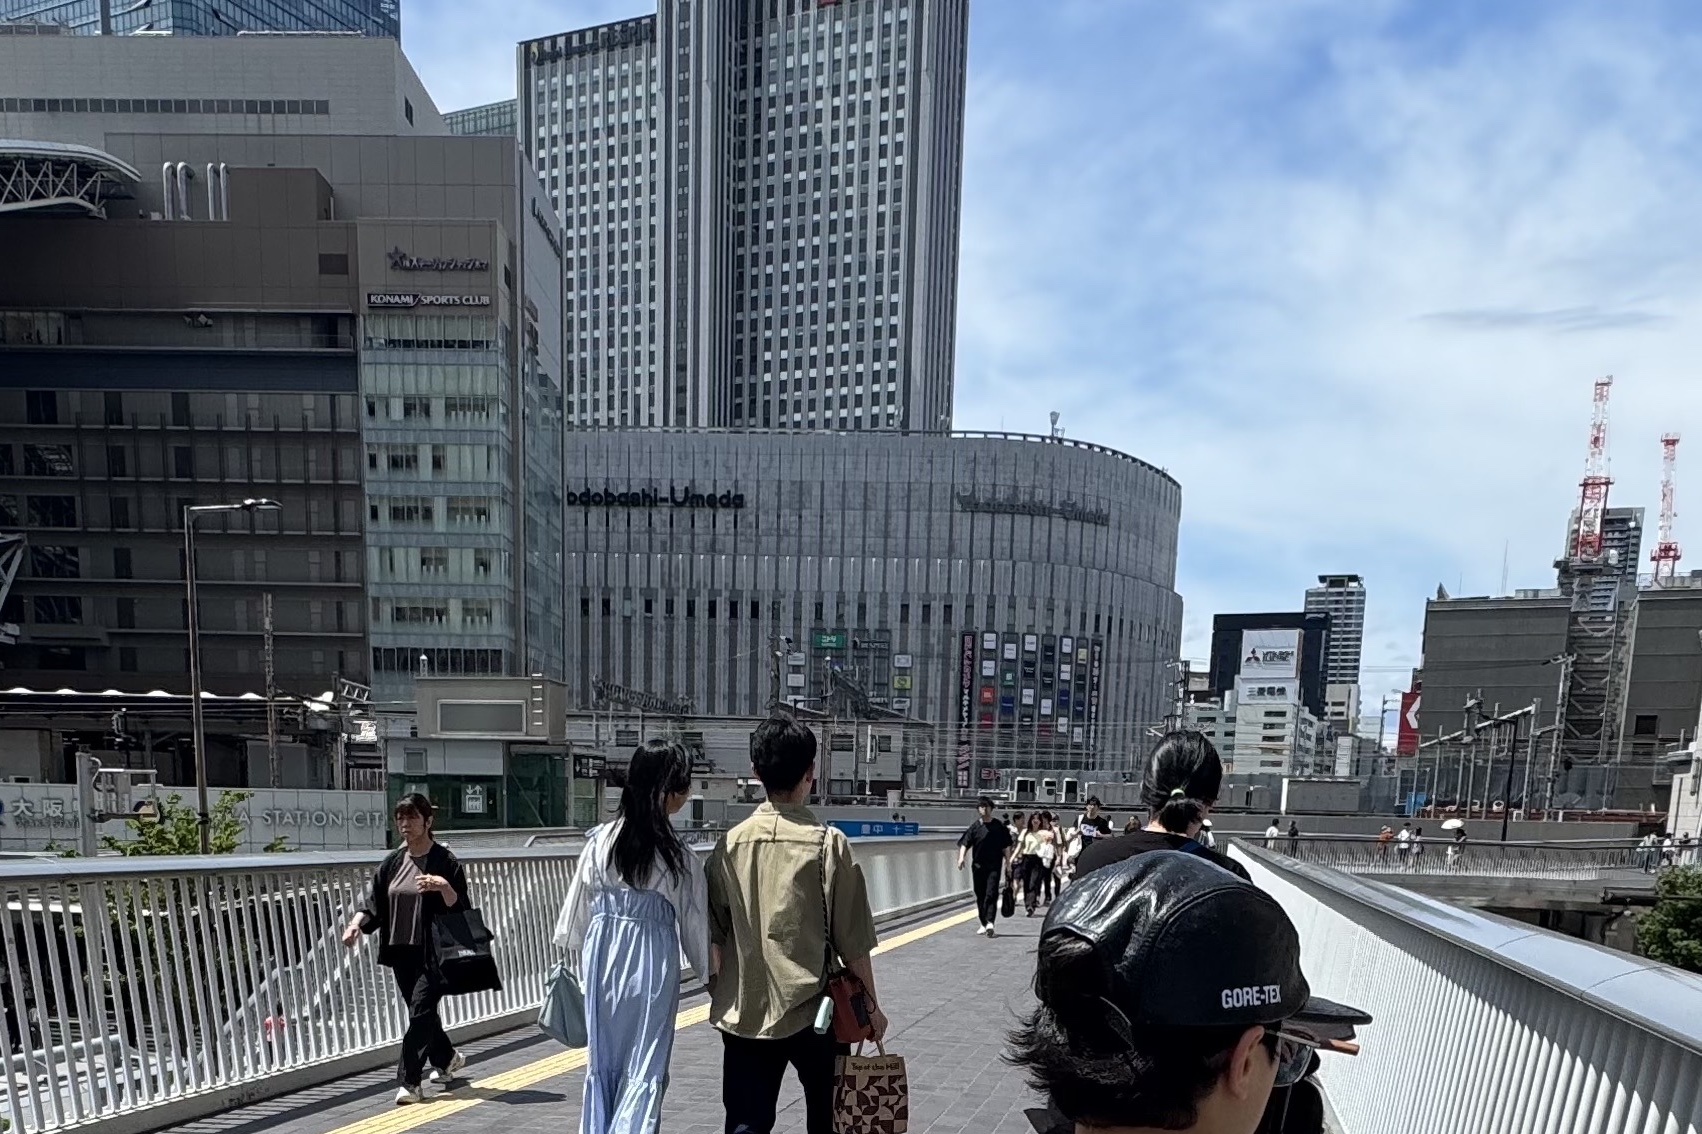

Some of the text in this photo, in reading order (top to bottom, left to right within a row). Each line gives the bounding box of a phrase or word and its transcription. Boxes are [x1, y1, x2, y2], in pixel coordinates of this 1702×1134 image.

[370, 294, 490, 305] KONAMI SPORTS CLUB
[566, 485, 744, 508] odobashi-Umeda
[262, 810, 343, 827] STATION
[353, 811, 385, 828] CIT
[1221, 984, 1282, 1009] GORE-TEX
